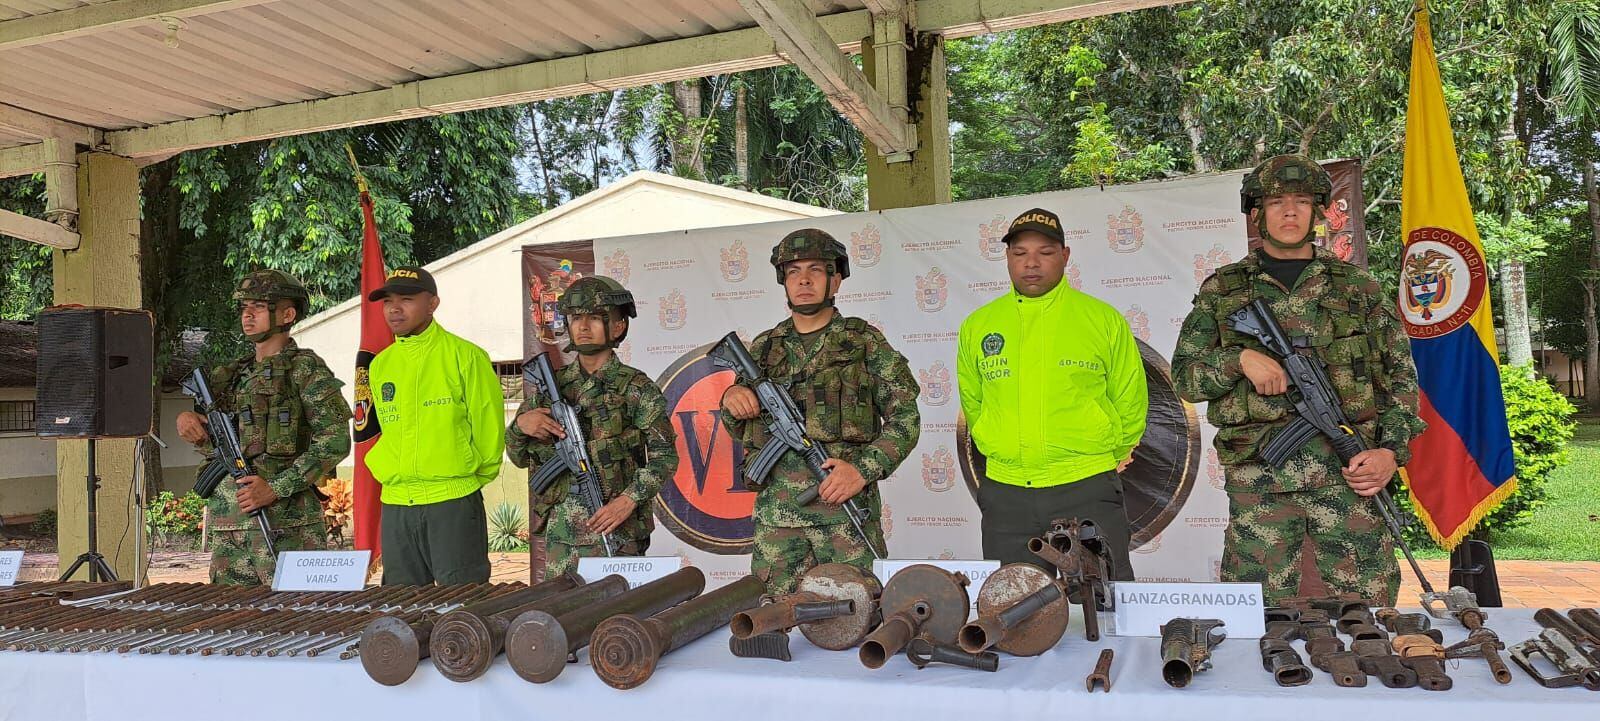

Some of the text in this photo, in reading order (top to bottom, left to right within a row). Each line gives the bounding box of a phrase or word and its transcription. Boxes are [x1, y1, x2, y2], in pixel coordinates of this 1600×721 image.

[1011, 213, 1058, 229] POLICIA
[1199, 217, 1236, 225] NACIONAL
[1413, 230, 1482, 279] DE COLOMBIA
[1101, 274, 1172, 285] EJERCITO NACIONAL
[981, 358, 1008, 370] SIJIN
[296, 558, 355, 567] CORREDERAS
[602, 562, 653, 573] MORTERO
[306, 574, 339, 583] VARIAS
[1121, 592, 1257, 606] LANZAGRANADAS
